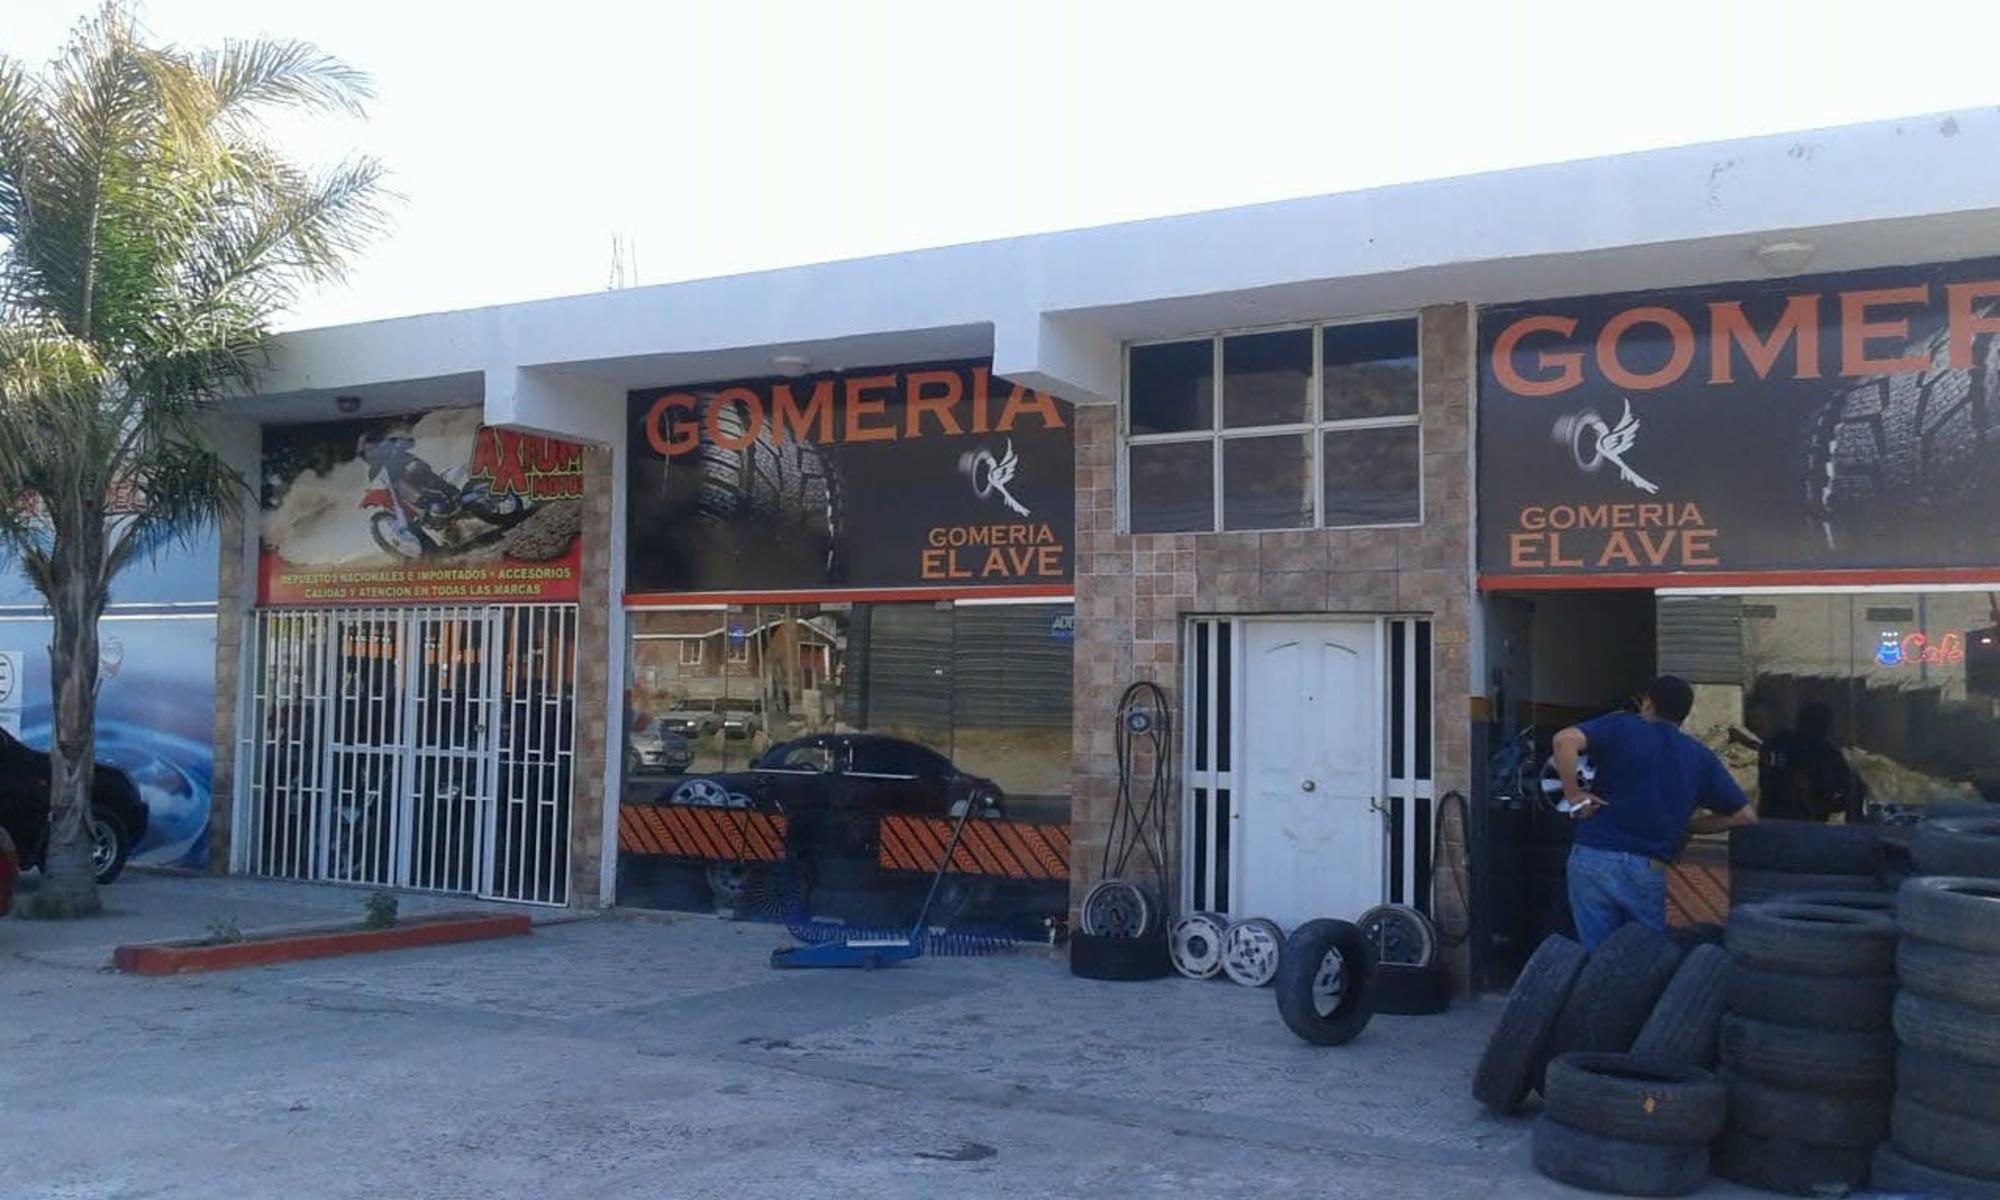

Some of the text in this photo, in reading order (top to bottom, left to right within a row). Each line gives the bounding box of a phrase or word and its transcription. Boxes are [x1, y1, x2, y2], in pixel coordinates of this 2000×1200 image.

[645, 365, 1065, 457] GOMERIA
[1519, 502, 1705, 529] GOMERIA
[928, 524, 1055, 548] GOMERIA
[1509, 528, 1719, 569] EL AVE
[417, 569, 487, 581] IMPORTADOS
[498, 567, 571, 579] ACCESORIOS
[921, 545, 1064, 579] EL AVE
[414, 586, 429, 596] EN
[431, 585, 466, 595] TODAS
[470, 585, 491, 594] LAS
[494, 584, 541, 594] MARCAS
